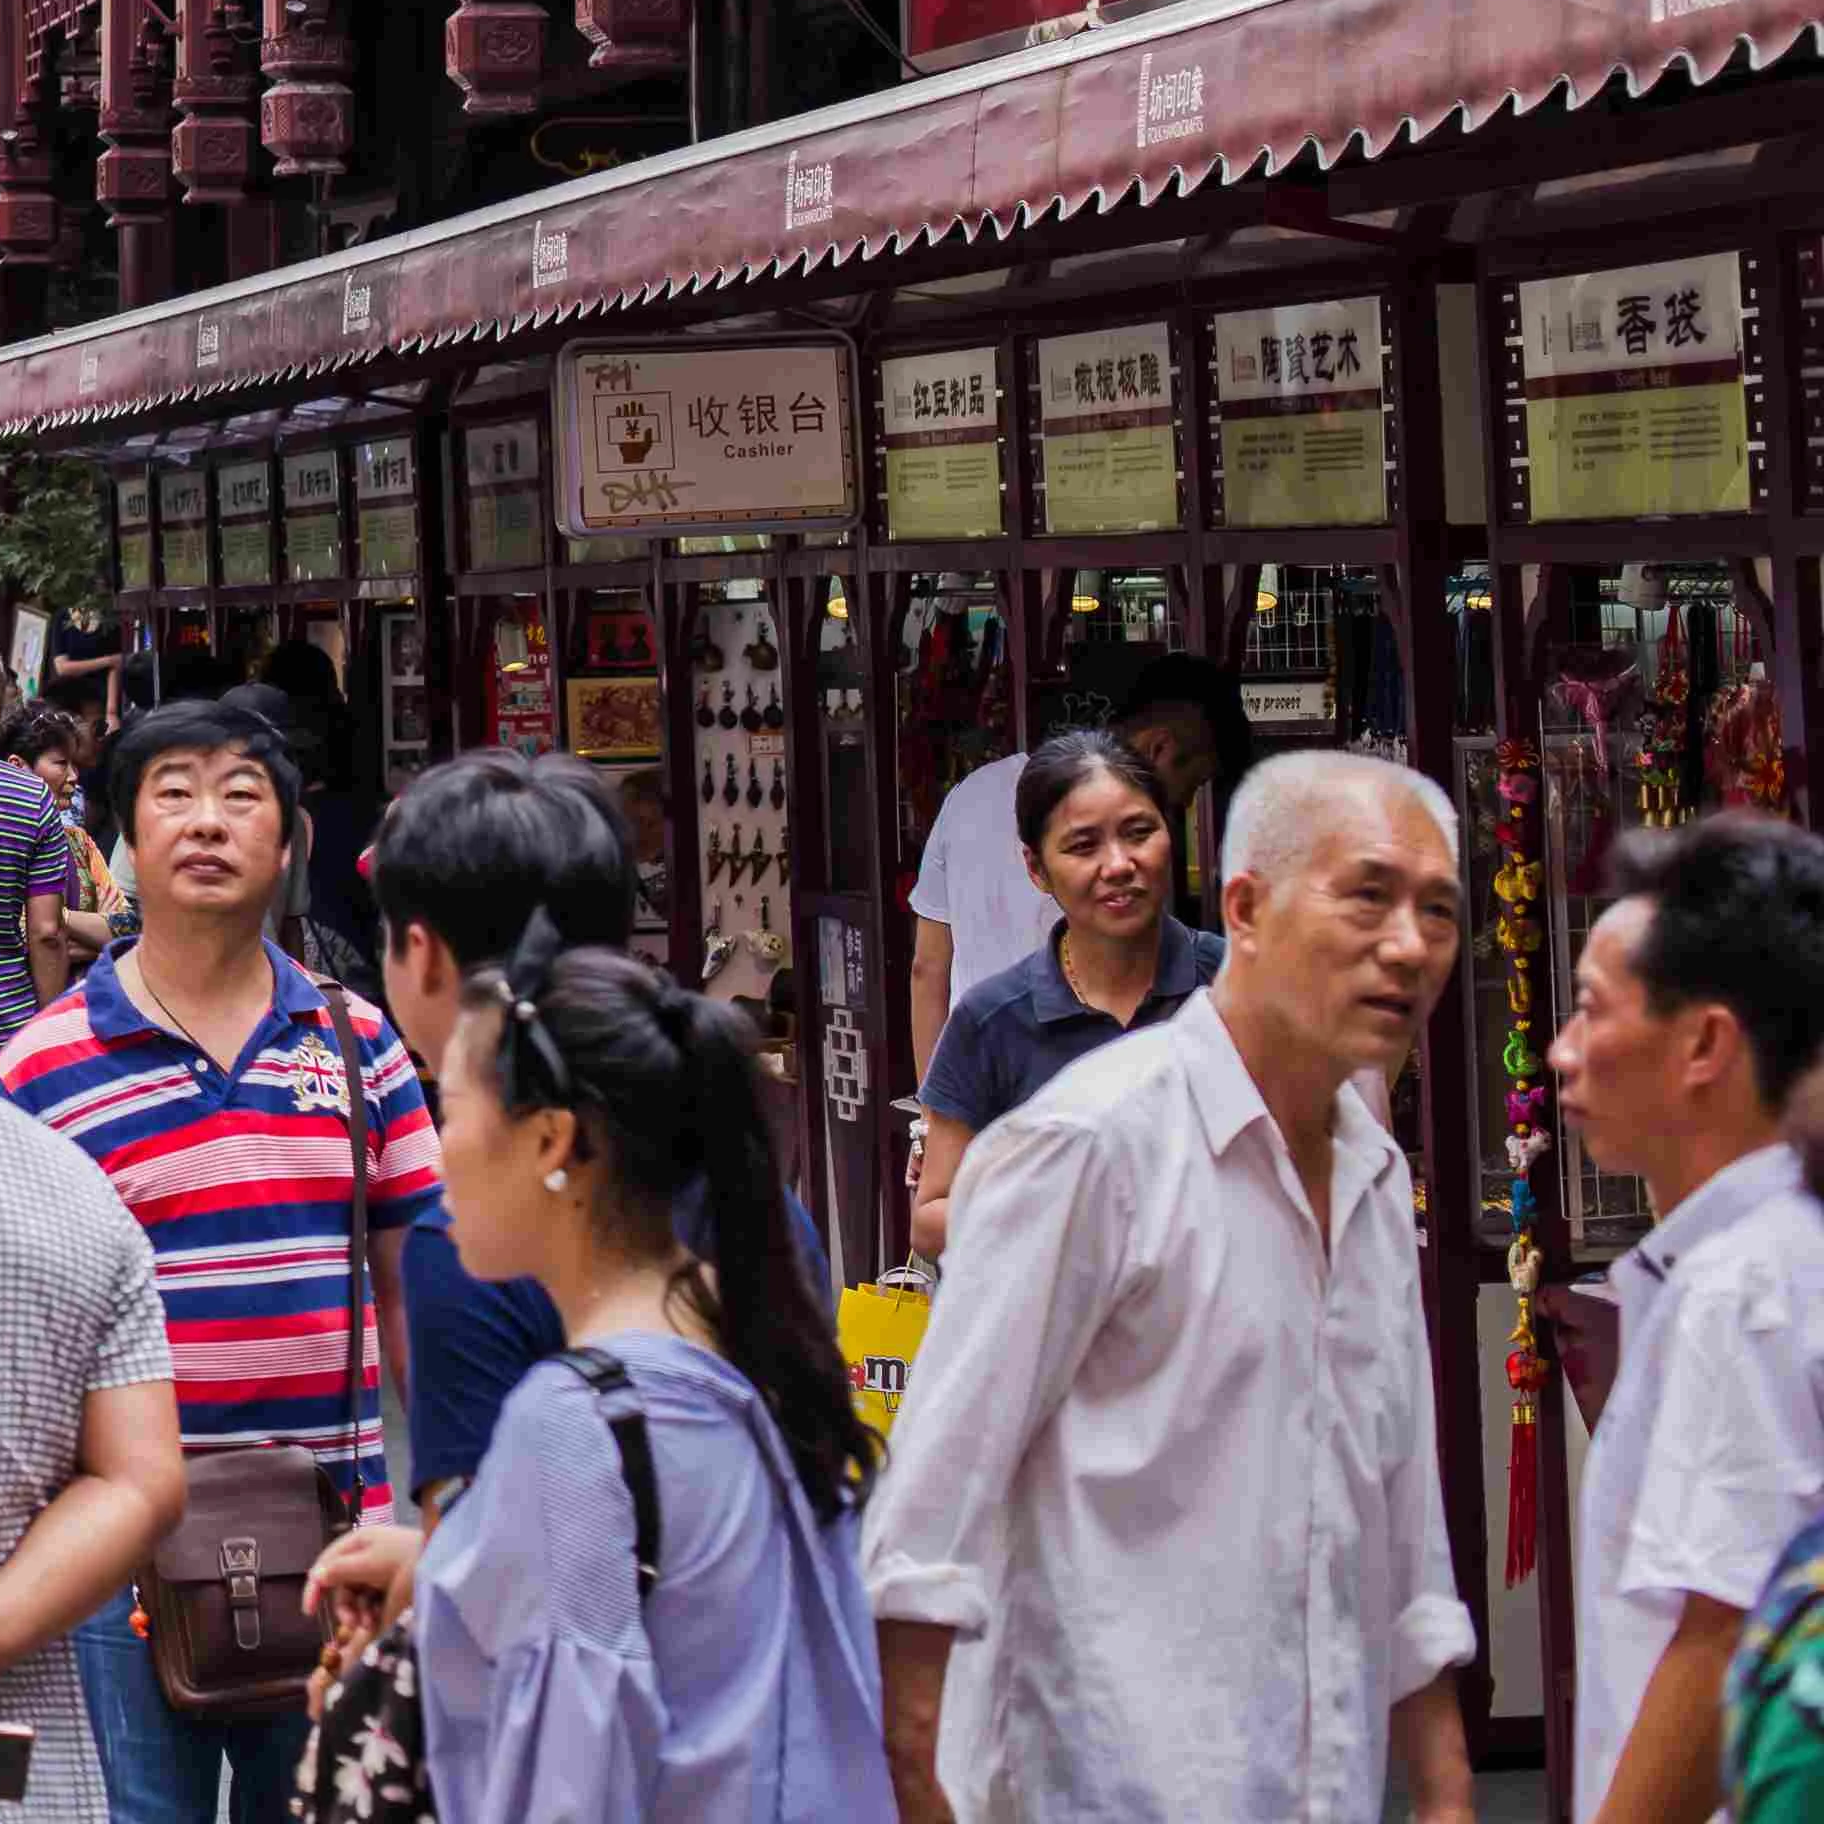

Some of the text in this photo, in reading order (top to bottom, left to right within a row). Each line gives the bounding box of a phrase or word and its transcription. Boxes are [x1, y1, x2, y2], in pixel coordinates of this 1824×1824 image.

[1149, 65, 1204, 121] 坊间印象
[1617, 289, 1708, 356] 香袋
[1261, 328, 1360, 385] 陶瓷艺术
[687, 390, 828, 439] 收银台
[913, 374, 985, 422] 红豆制品
[723, 442, 794, 459] Cashier
